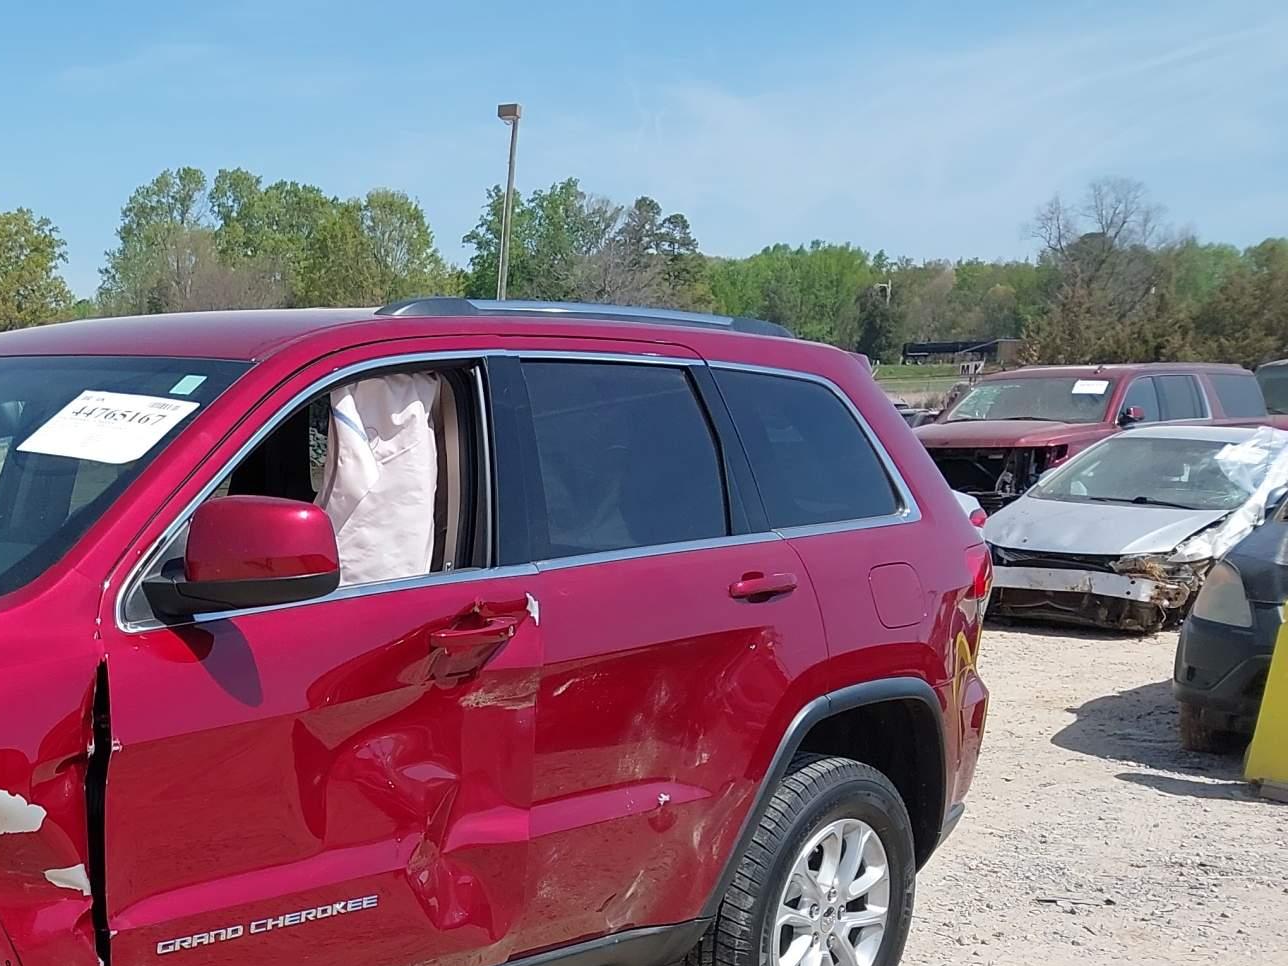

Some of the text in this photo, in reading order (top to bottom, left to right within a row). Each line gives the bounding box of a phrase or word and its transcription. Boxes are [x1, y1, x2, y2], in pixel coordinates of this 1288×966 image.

[72, 404, 167, 427] 44765167
[156, 894, 379, 955] GRAND CHEROKEE
